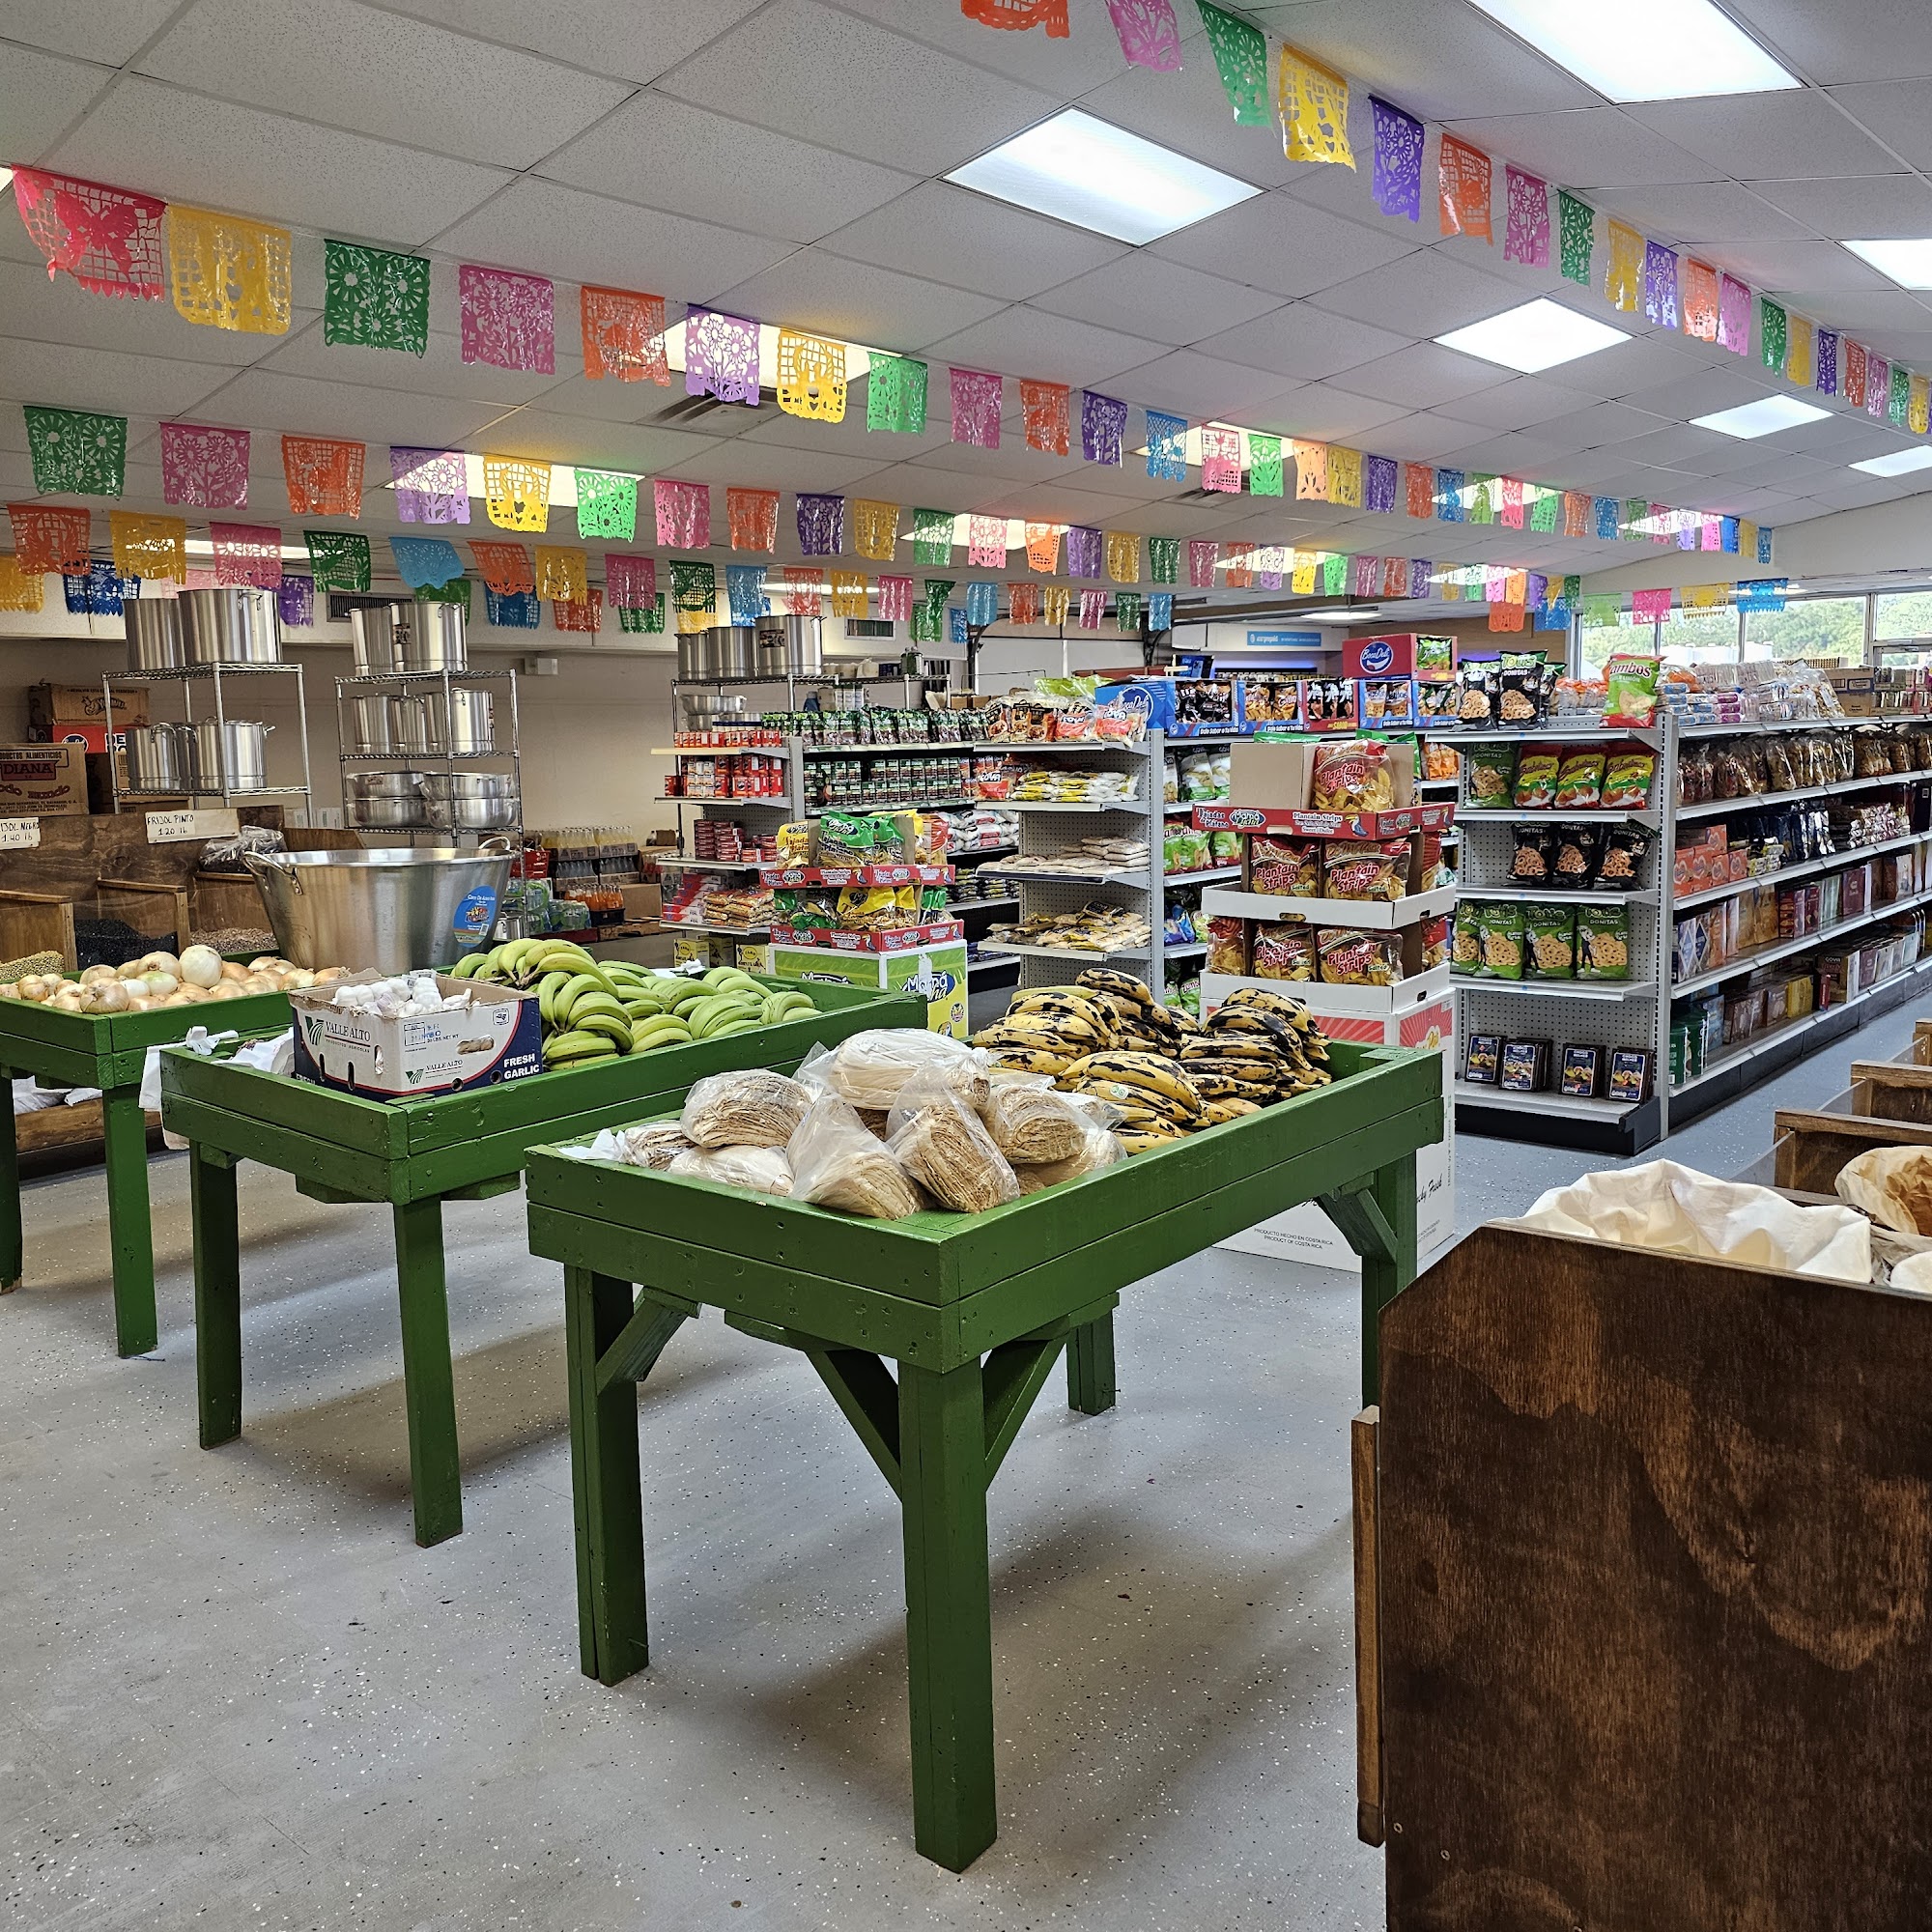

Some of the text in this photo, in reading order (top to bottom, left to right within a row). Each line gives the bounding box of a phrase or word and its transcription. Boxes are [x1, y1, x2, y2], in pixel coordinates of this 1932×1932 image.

[1609, 662, 1652, 677] ambos
[4, 763, 54, 774] DIANA
[1320, 762, 1364, 784] Plantain
[1293, 812, 1342, 822] Plantain Strips
[1256, 864, 1299, 879] Plantain
[1331, 863, 1379, 881] Plantain
[1264, 873, 1296, 890] Strips
[1337, 952, 1372, 975] Strips
[326, 1021, 370, 1042] VALLE ALTO
[445, 1059, 464, 1067] ALTO
[503, 1053, 535, 1068] FRESH
[503, 1065, 540, 1080] GARLIC
[1254, 1228, 1280, 1236] PRODUCTO
